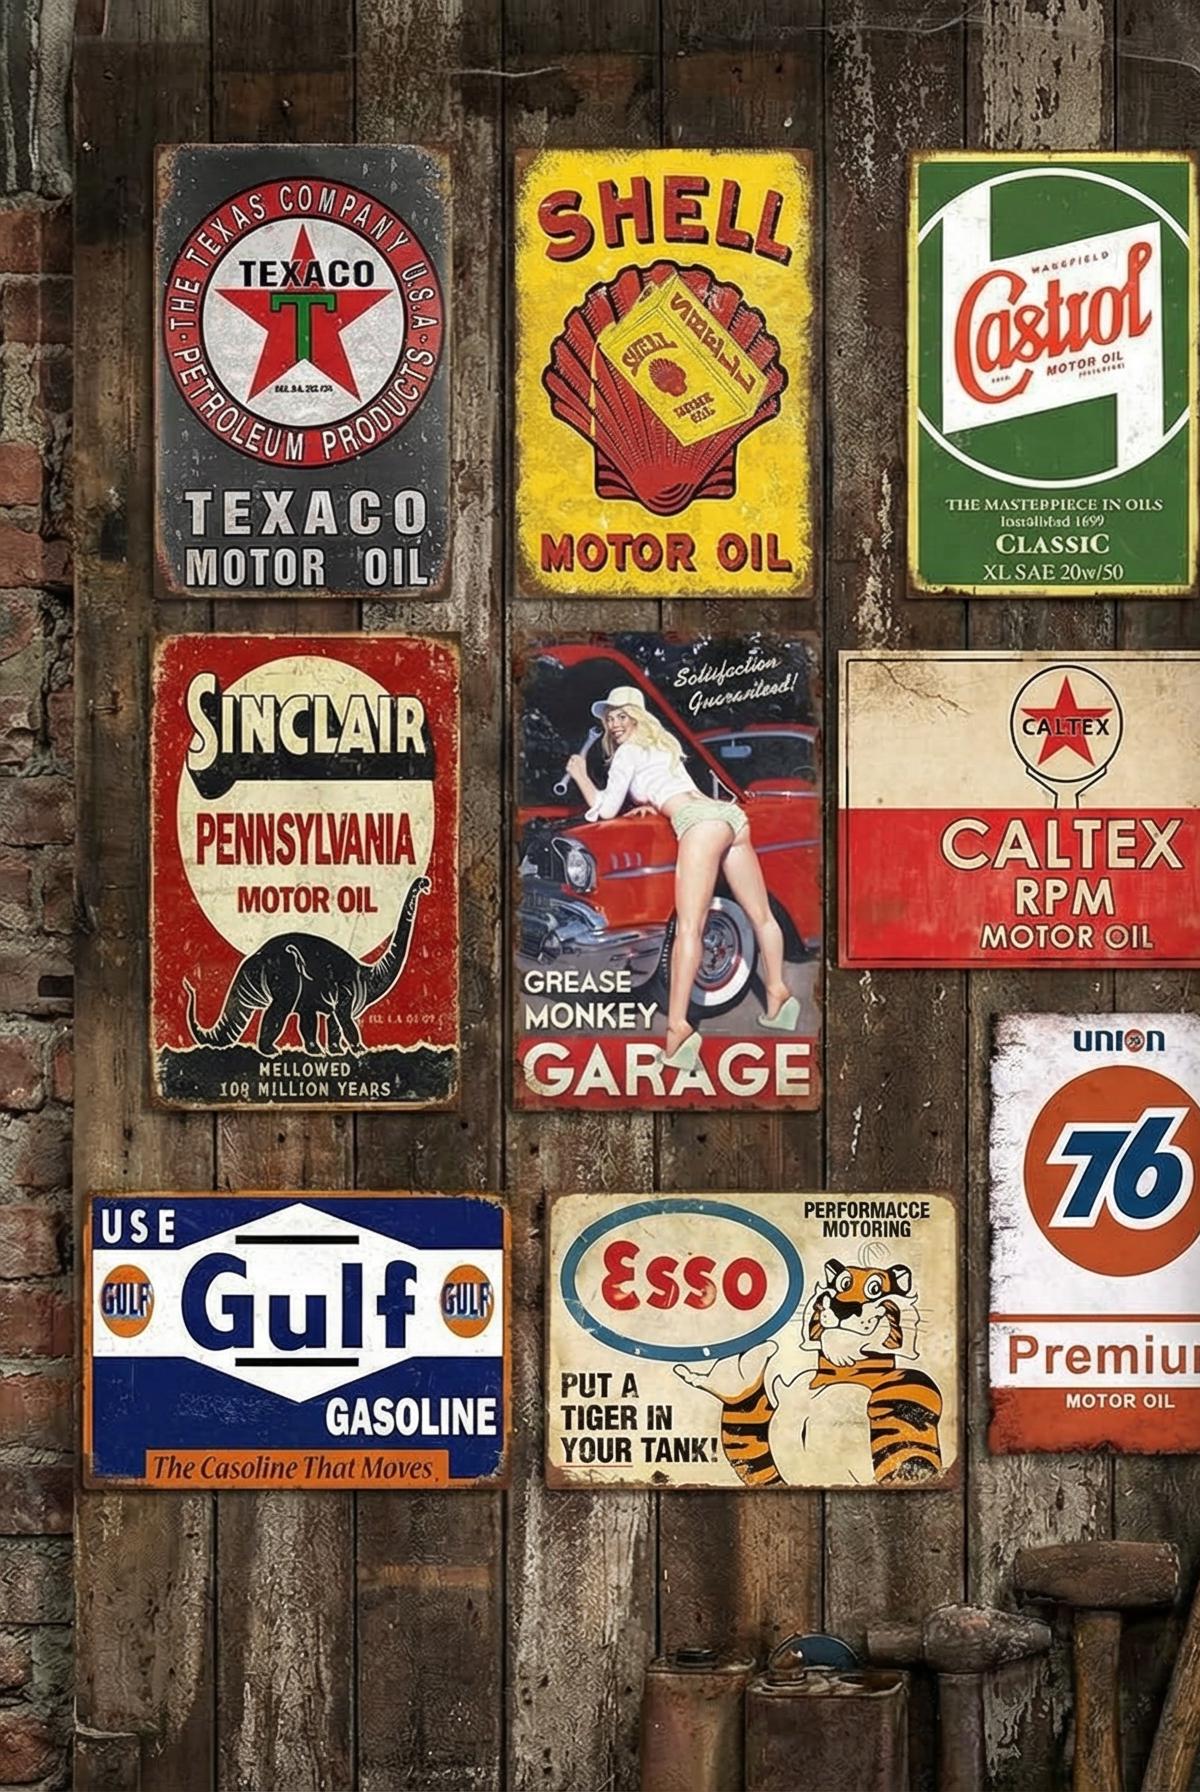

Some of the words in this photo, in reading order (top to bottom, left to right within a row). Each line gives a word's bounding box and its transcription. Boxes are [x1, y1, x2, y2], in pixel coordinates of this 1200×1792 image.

[537, 174, 793, 267] SHELL
[169, 274, 200, 331] THE
[188, 193, 266, 266] TEXAS
[279, 184, 411, 253] COMPANY
[239, 260, 375, 287] TEXACO
[270, 292, 337, 363] T
[954, 240, 1153, 405] Castrol
[1046, 356, 1097, 376] MOTOR
[1102, 351, 1124, 364] OIL
[172, 346, 304, 462] PETROLEUM
[321, 349, 435, 462] PRODUCTS
[184, 488, 429, 536] TEXACO
[945, 498, 980, 511] THE
[1102, 499, 1121, 511] IN
[1125, 499, 1163, 511] OILS
[540, 532, 698, 574] MOTOR
[716, 532, 794, 574] OIL
[995, 533, 1110, 554] CLASSIC
[185, 547, 326, 588] MOTOR
[363, 547, 430, 586] OIL
[983, 564, 1011, 581] XL
[1015, 564, 1055, 581] SAE
[186, 671, 428, 771] SINCLAIR
[1021, 717, 1111, 737] CALTEX
[196, 812, 416, 866] PENNSYLVANIA
[940, 816, 1184, 872] CALTEX
[237, 886, 331, 913] MOTOR
[337, 886, 378, 913] OIL
[1013, 877, 1117, 918] RPM
[979, 923, 1095, 951] MOTOR
[1104, 924, 1156, 950] OIL
[524, 969, 632, 994] GREASE
[524, 1001, 659, 1031] MONKEY
[523, 1041, 812, 1098] GARAGE
[258, 1081, 329, 1096] MILLION
[337, 1082, 391, 1096] YEARS
[1045, 1106, 1197, 1232] 76
[101, 1208, 177, 1245] USE
[822, 1220, 912, 1238] MOTORING
[181, 1251, 418, 1351] Gulf
[561, 1373, 612, 1398] PUT
[621, 1373, 640, 1398] A
[1065, 1393, 1137, 1410] MOTOR
[1143, 1393, 1175, 1410] OIL
[325, 1396, 498, 1436] GASOLINE
[561, 1405, 638, 1431] TIGER
[646, 1405, 673, 1431] IN
[561, 1437, 632, 1463] YOUR
[640, 1436, 719, 1463] TANK!
[153, 1456, 196, 1480] The
[303, 1456, 356, 1481] That
